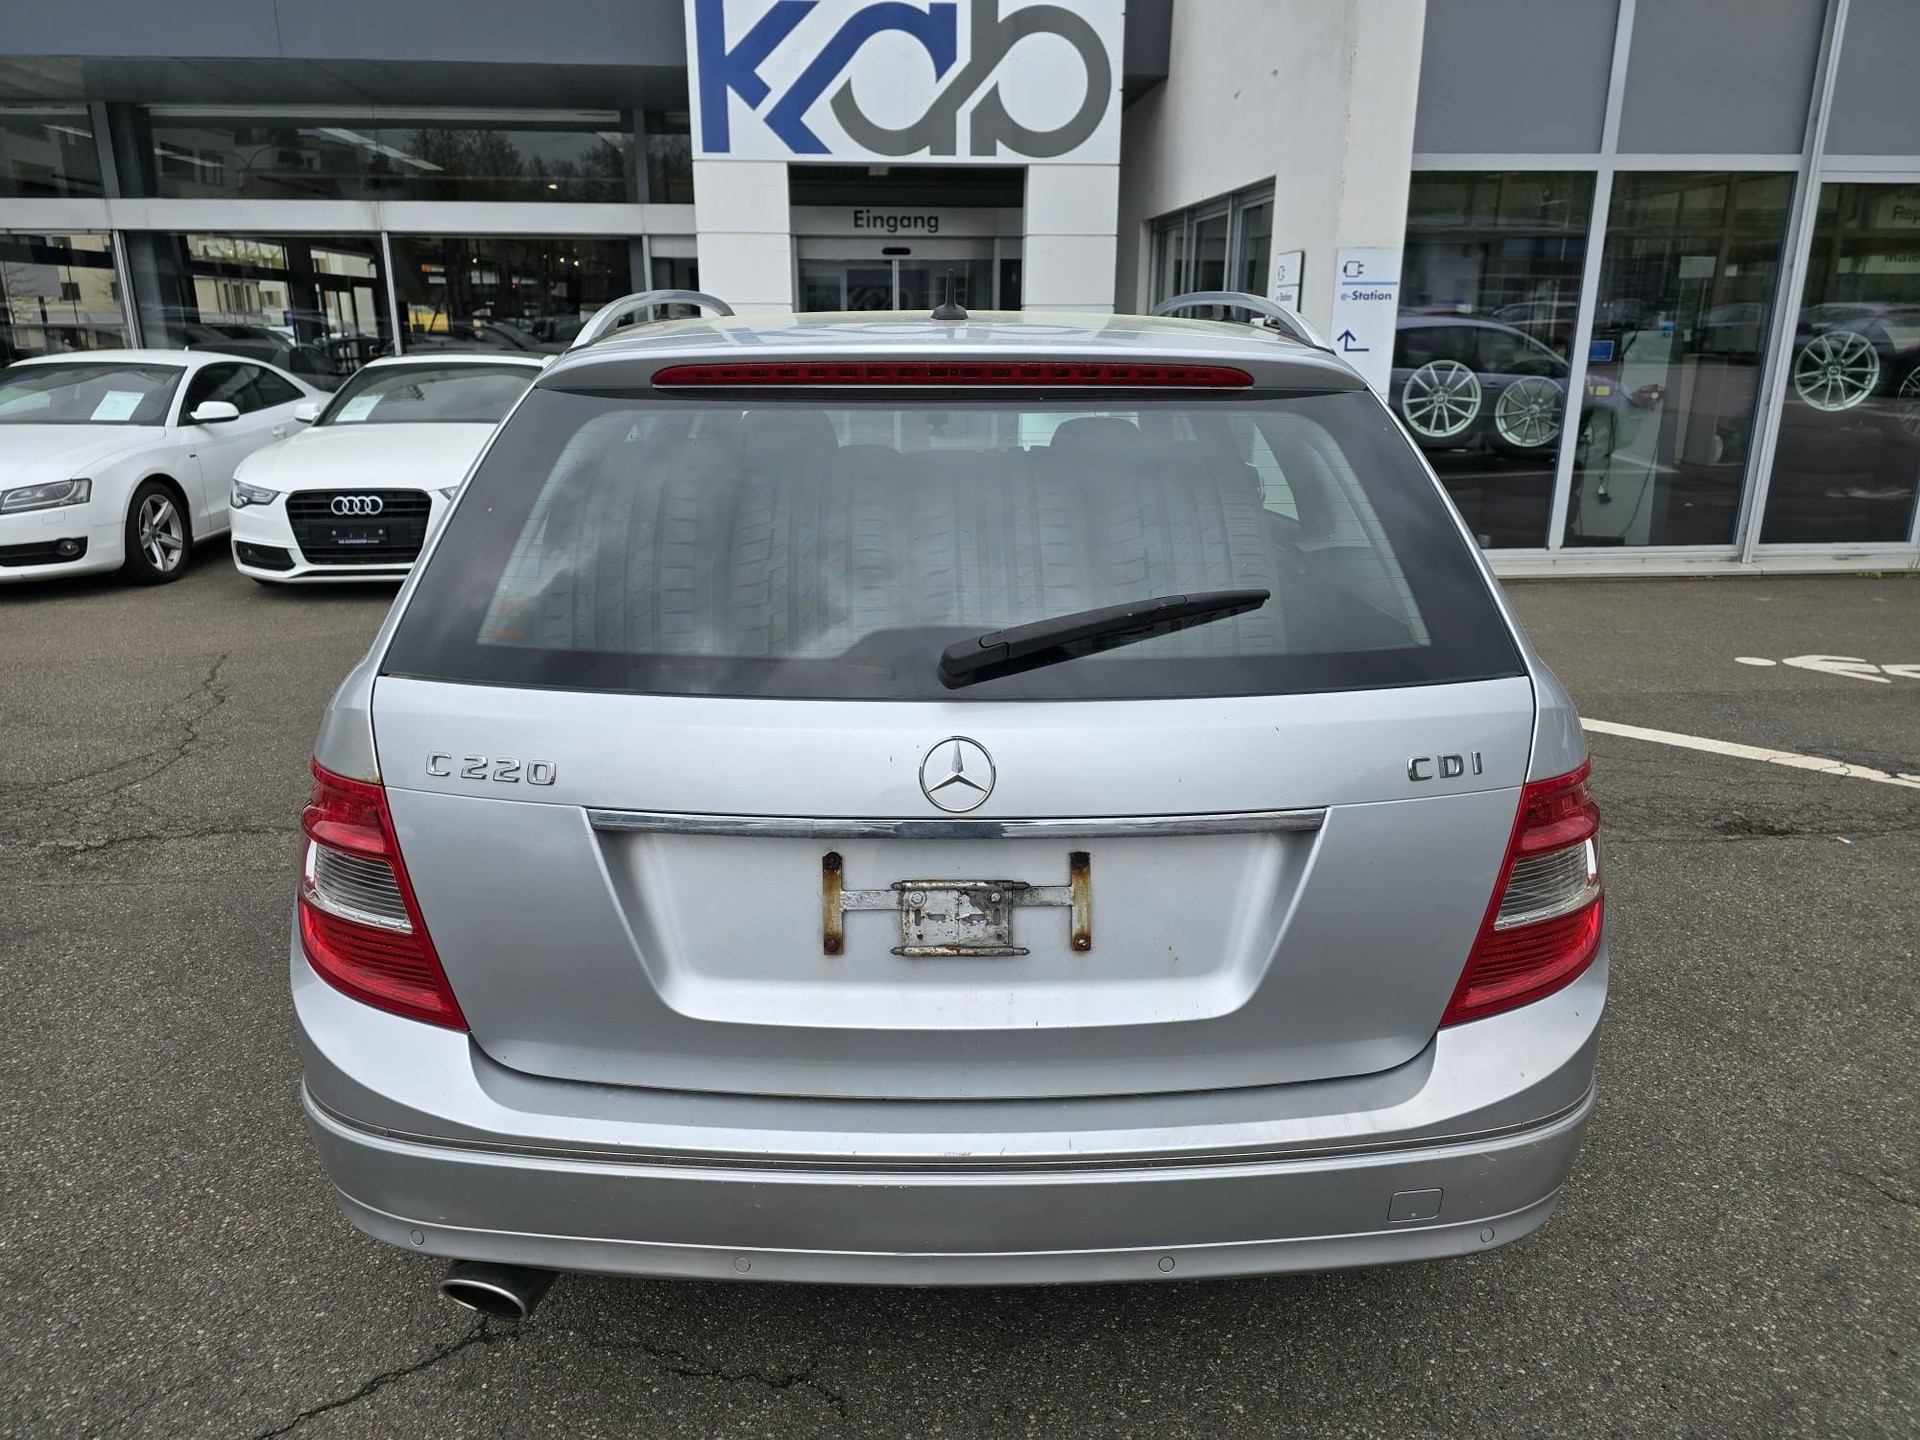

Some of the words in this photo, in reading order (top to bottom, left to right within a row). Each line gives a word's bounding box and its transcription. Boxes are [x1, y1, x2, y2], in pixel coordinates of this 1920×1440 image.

[853, 209, 940, 234] Eingang
[1340, 289, 1392, 301] e-Station
[425, 750, 452, 777] C
[460, 754, 557, 786] 220
[1406, 750, 1483, 782] CDI
